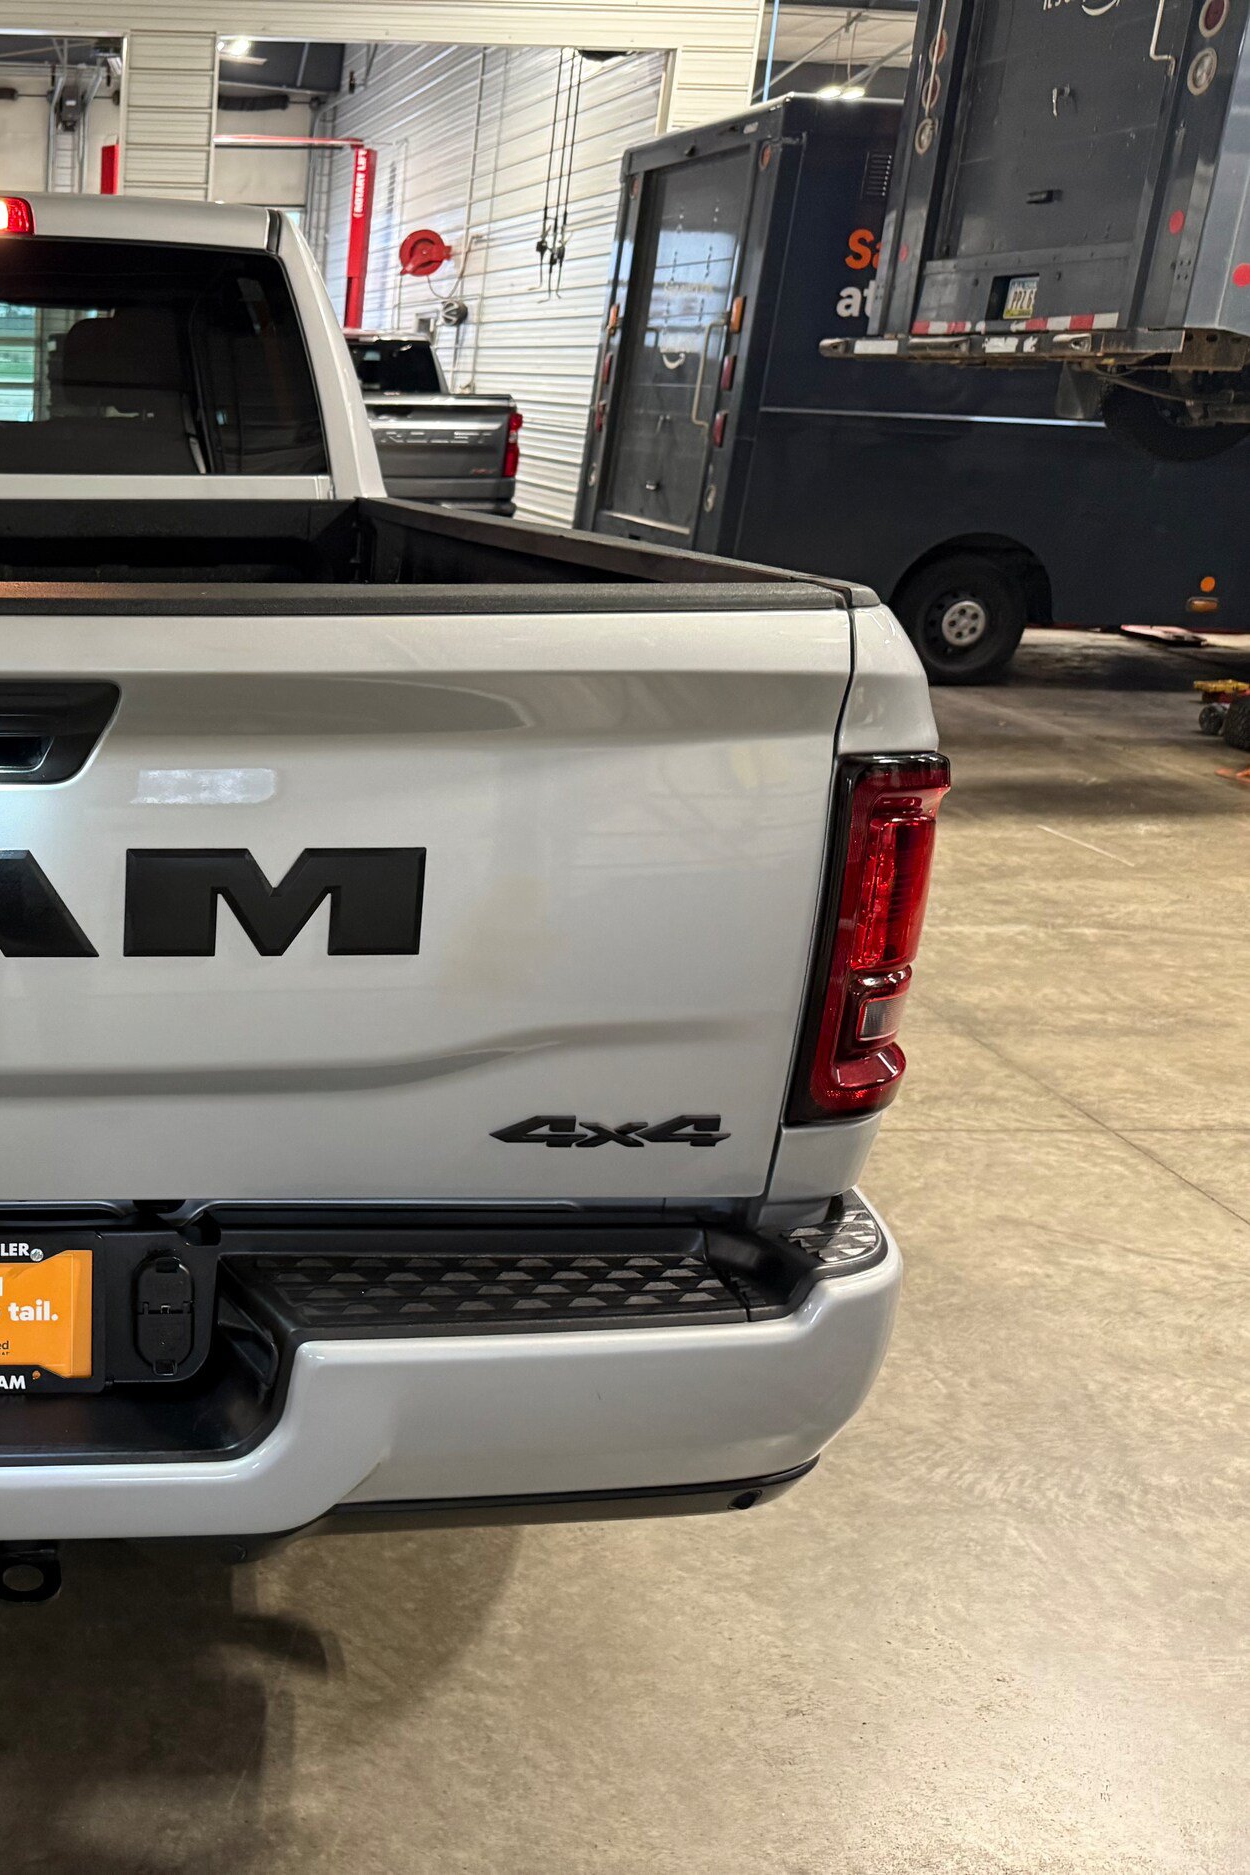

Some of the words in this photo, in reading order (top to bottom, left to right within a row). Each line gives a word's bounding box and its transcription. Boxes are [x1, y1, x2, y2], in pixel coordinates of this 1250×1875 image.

[357, 148, 367, 171] LIFT
[354, 173, 365, 213] ROTARY
[8, 1299, 58, 1321] tail.
